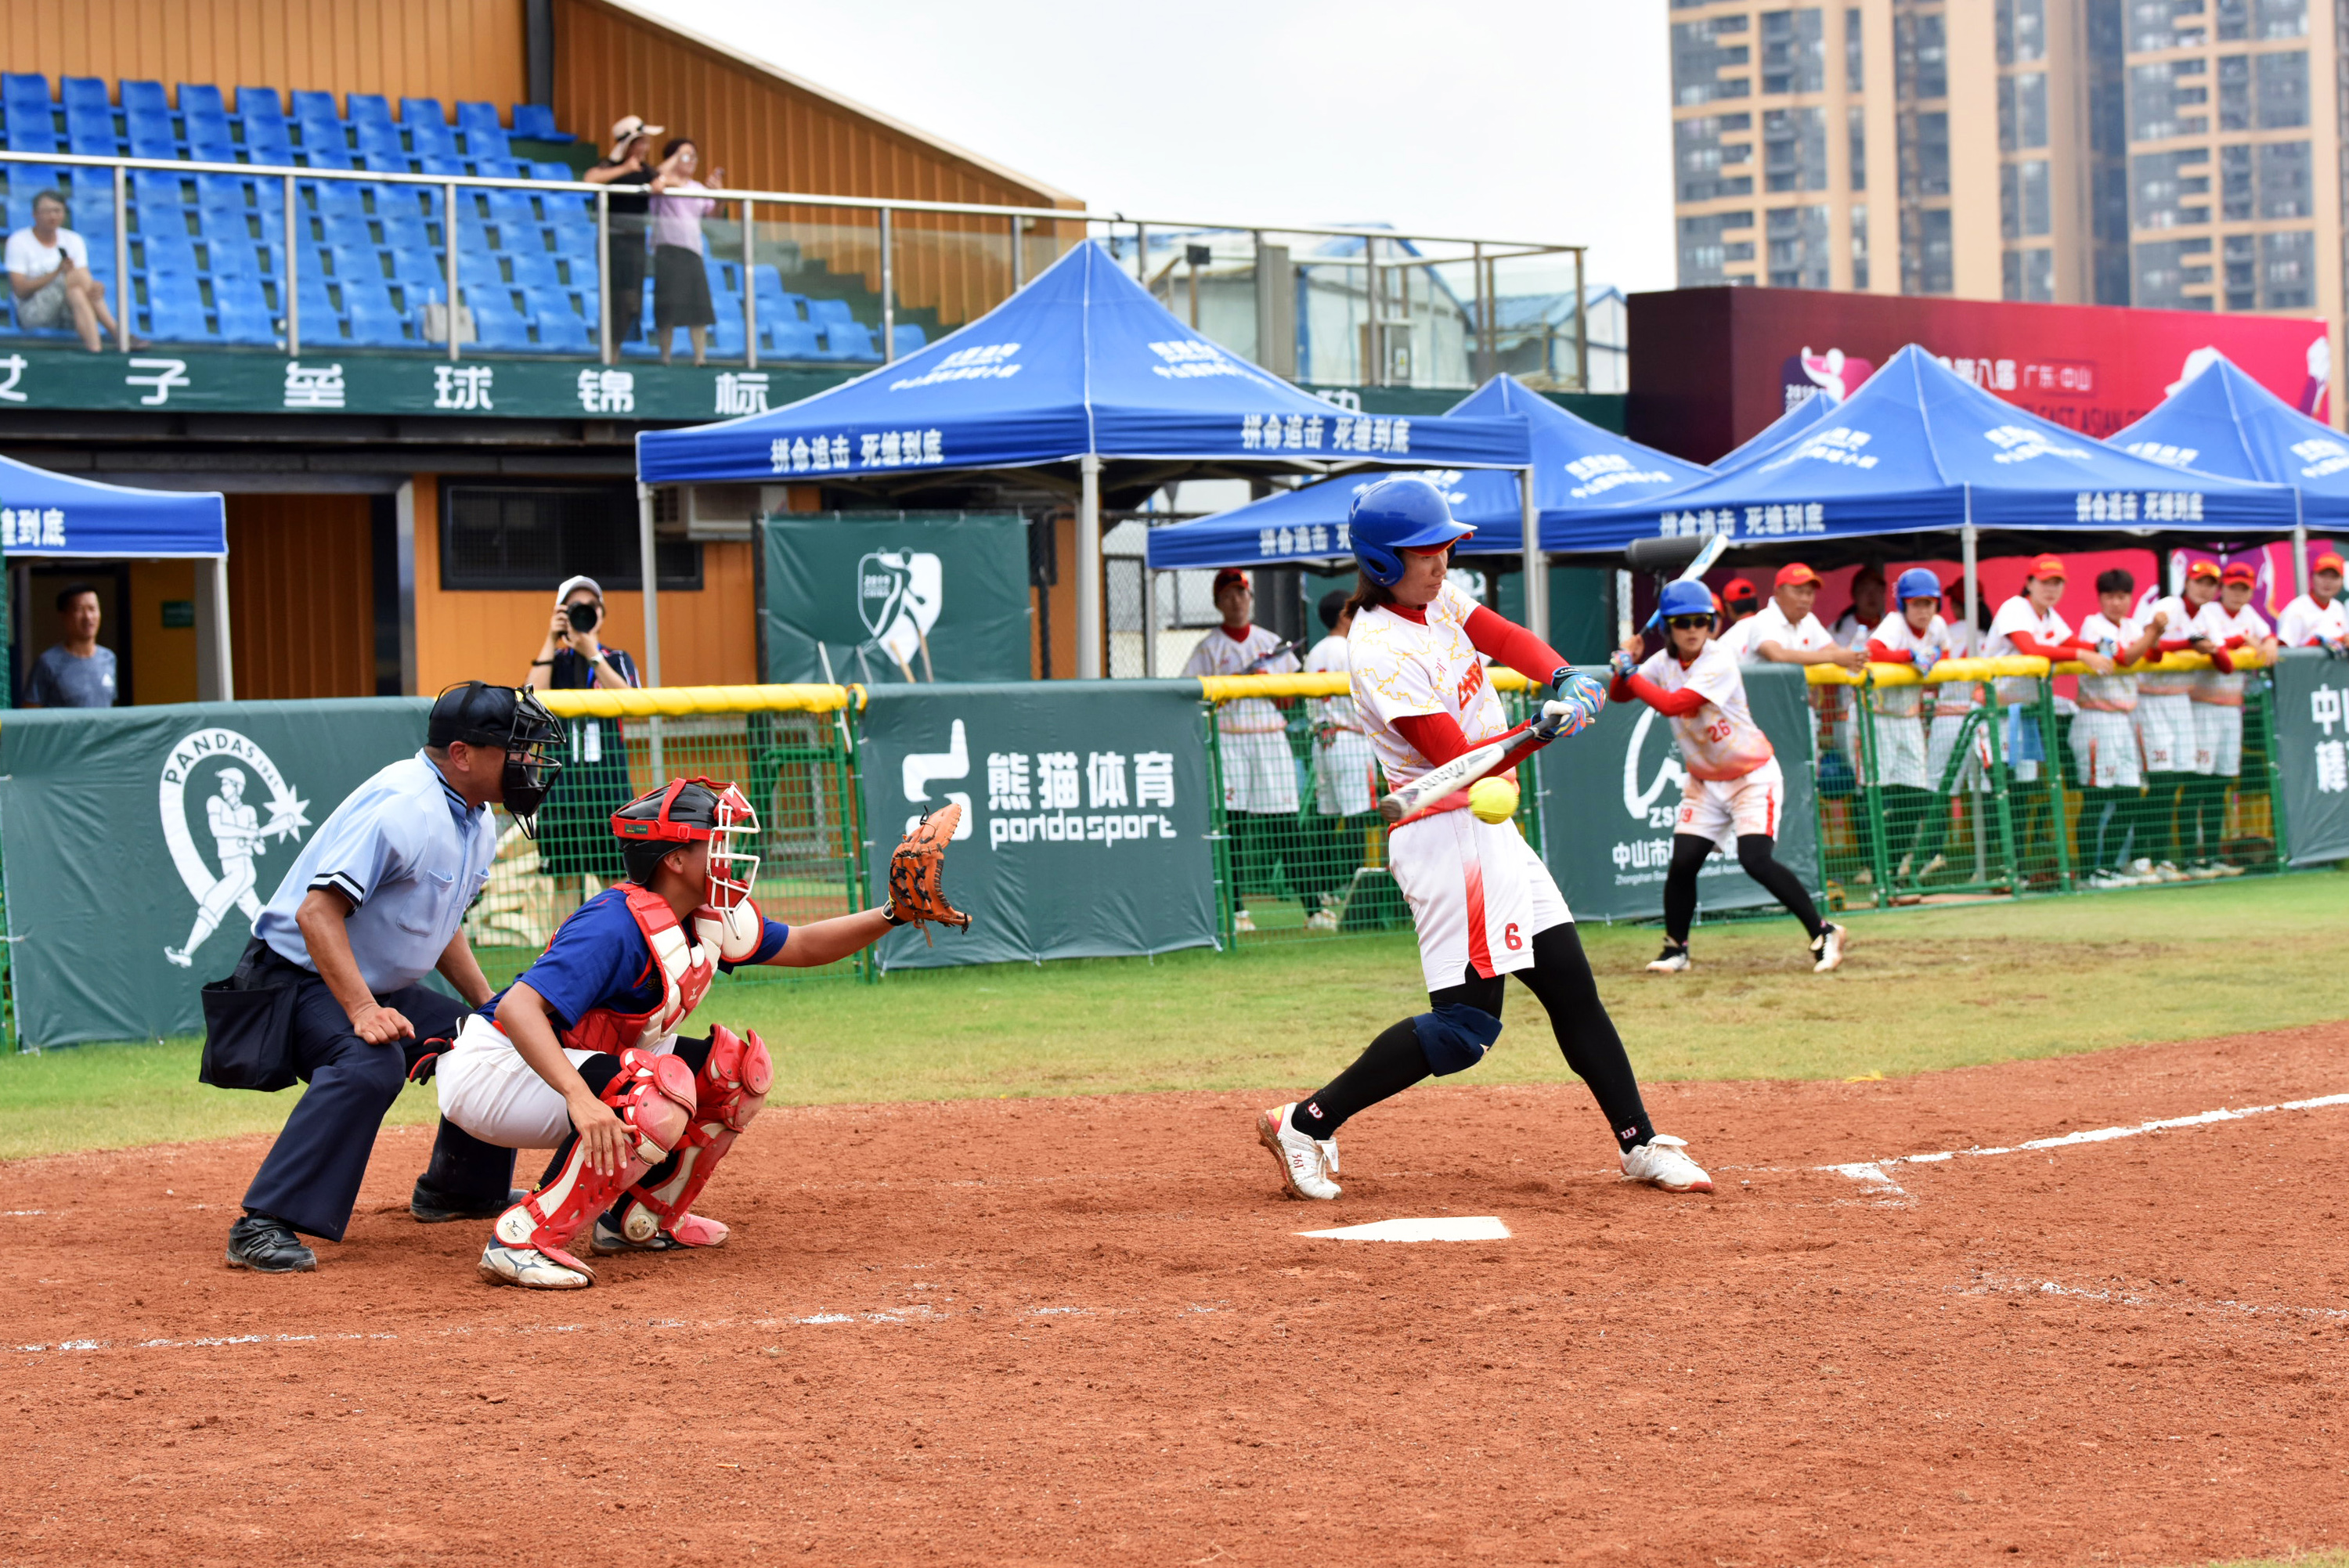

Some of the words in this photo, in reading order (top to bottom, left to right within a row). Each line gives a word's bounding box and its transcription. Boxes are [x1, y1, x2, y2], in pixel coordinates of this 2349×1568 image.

[770, 433, 850, 474] 拼命追击
[860, 427, 944, 467] 死缠到底
[1242, 414, 1324, 450] 拼命追击
[1333, 416, 1410, 454] 死缠到底
[1706, 719, 1731, 743] 26
[164, 734, 256, 785] PANDAS
[987, 751, 1175, 811] 熊猫体育
[989, 808, 1178, 852] pandasport
[1505, 922, 1523, 950] 6
